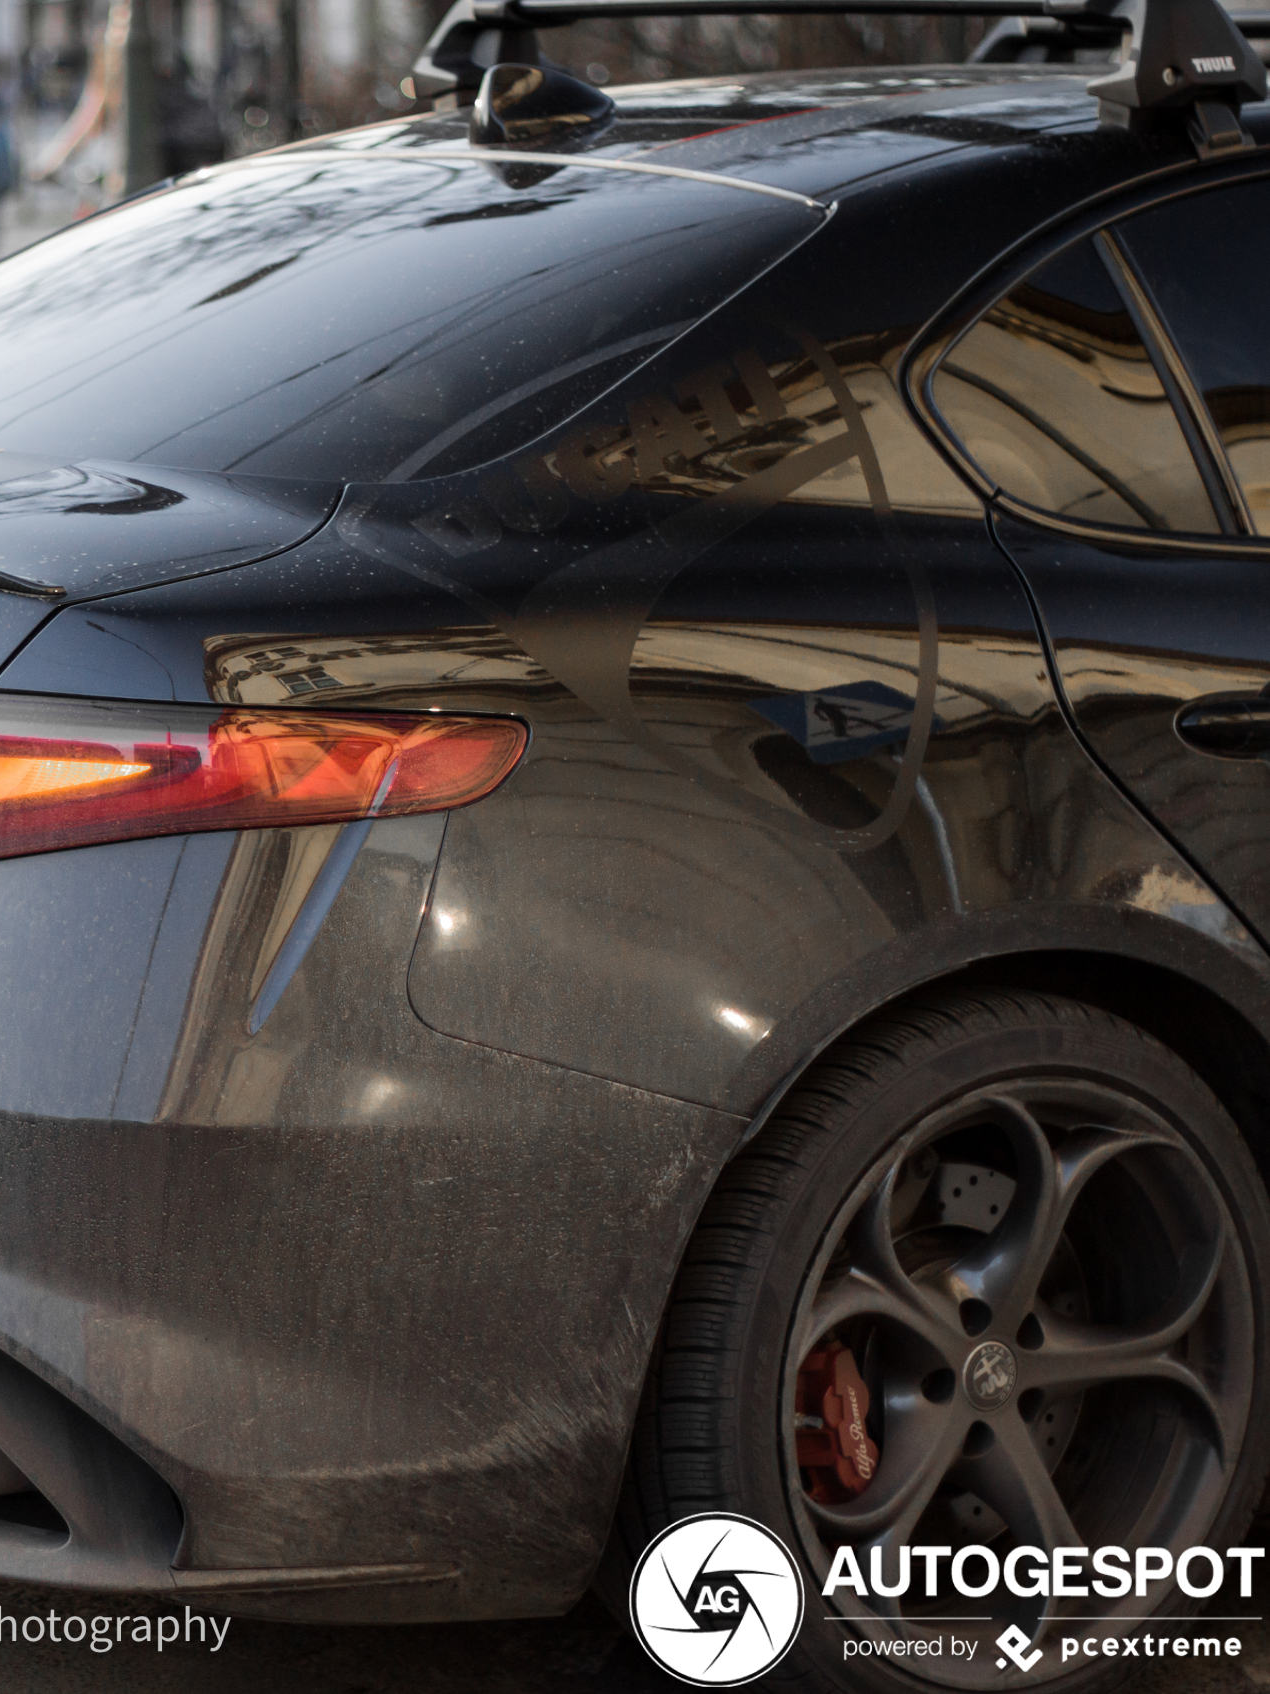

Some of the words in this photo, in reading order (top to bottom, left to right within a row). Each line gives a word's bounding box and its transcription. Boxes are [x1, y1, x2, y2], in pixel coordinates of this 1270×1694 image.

[1191, 56, 1237, 73] THULE
[409, 346, 788, 559] DUCATI
[846, 1386, 865, 1441] Romeo
[854, 1442, 876, 1480] Alfa
